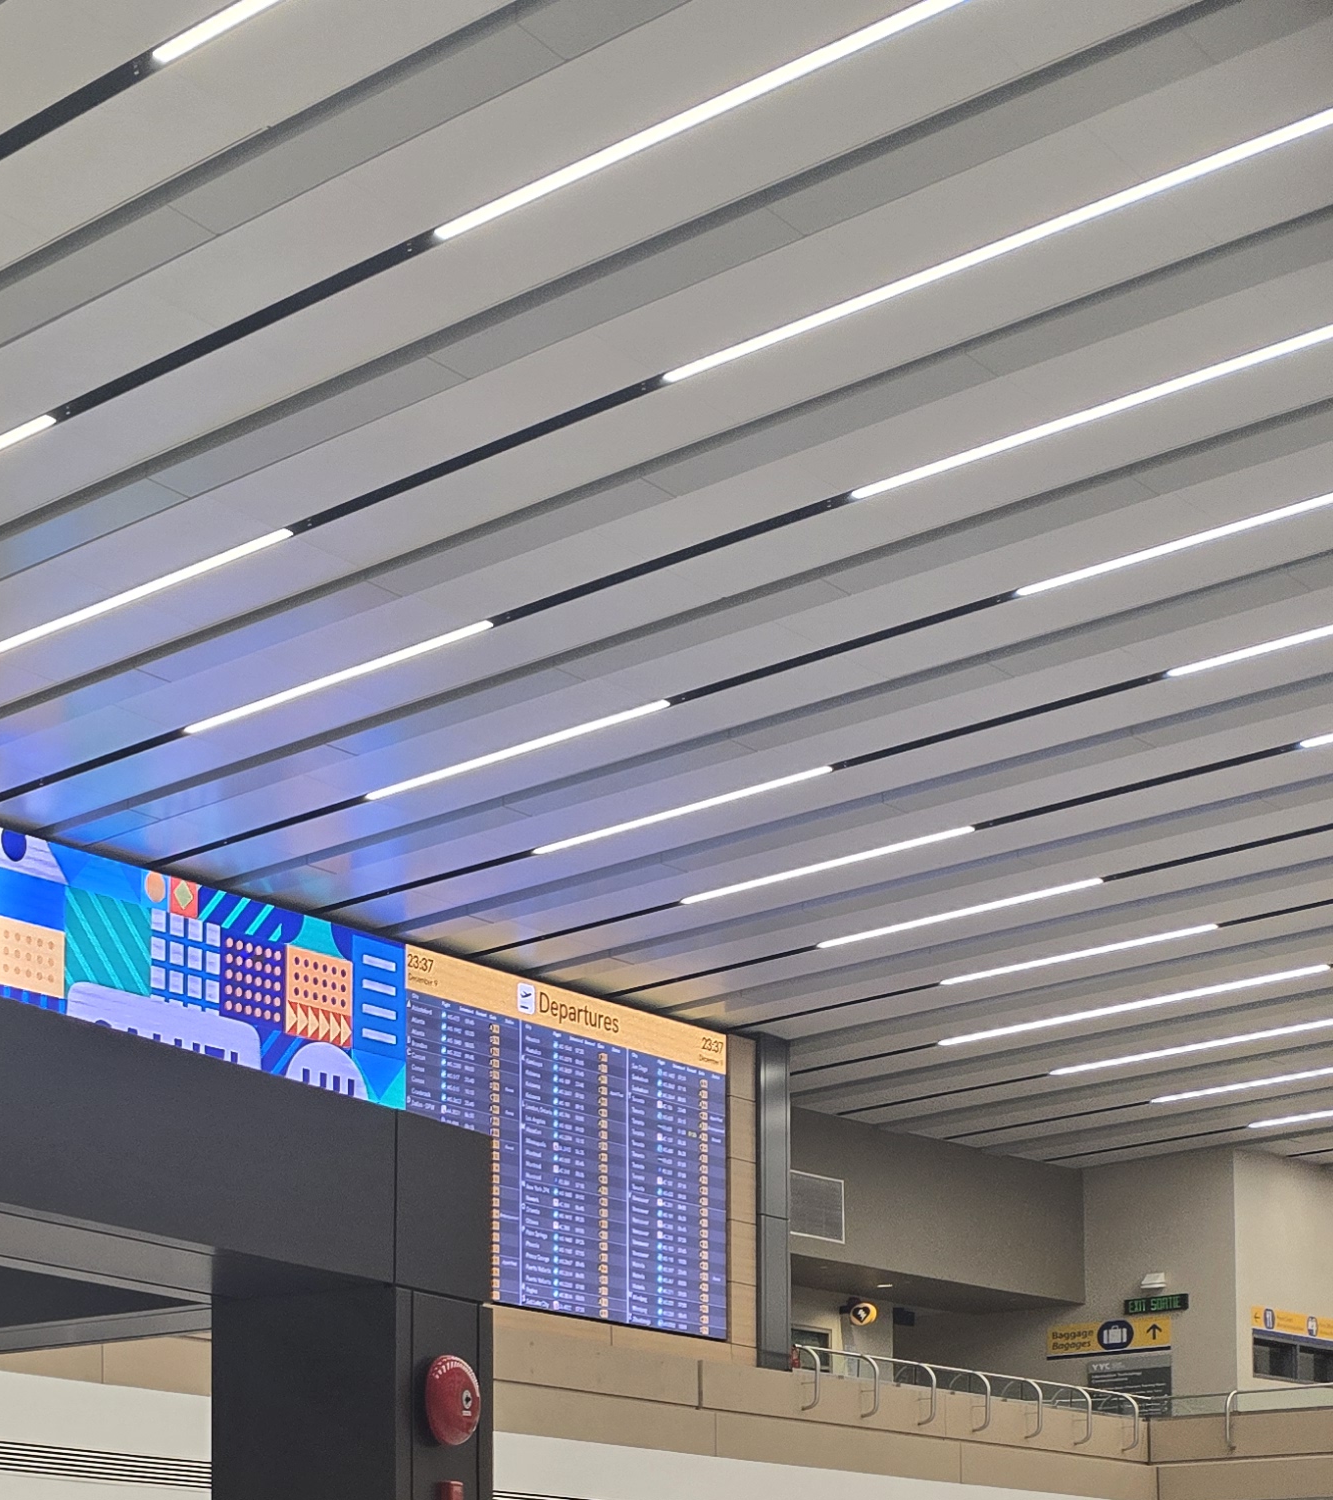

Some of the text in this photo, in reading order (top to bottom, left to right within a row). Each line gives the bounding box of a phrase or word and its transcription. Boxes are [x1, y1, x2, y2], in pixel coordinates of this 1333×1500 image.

[407, 954, 433, 972] 23:37
[539, 992, 619, 1033] Departures
[701, 1036, 723, 1054] 23:37
[1129, 1297, 1181, 1312] EXIT SORTIE
[1052, 1329, 1094, 1340] Baggage
[1052, 1341, 1091, 1351] Bagages
